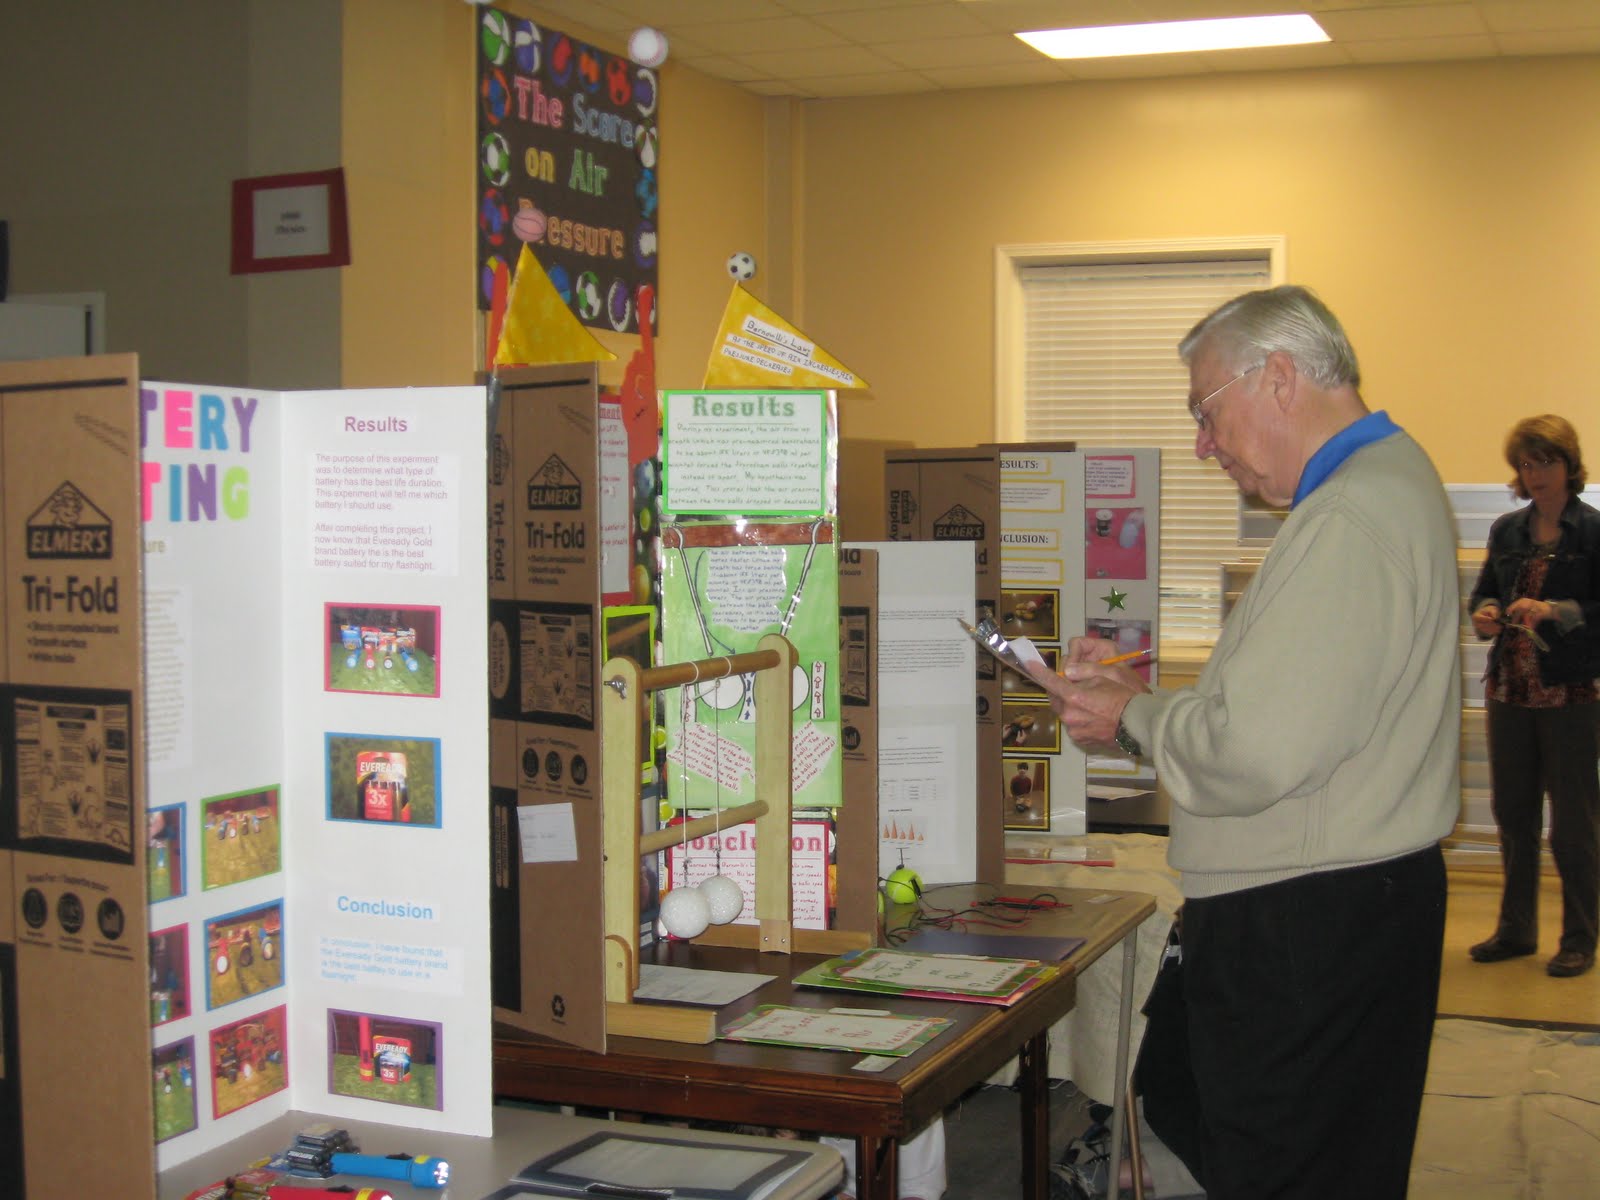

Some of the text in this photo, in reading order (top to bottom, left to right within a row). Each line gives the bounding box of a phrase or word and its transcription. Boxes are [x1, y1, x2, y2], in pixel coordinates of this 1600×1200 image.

[514, 75, 563, 128] The
[525, 147, 609, 196] on Air
[518, 198, 624, 259] essure
[743, 339, 755, 349] THE
[756, 343, 776, 354] SPEED
[723, 347, 792, 374] PRESSURE DECREASES
[692, 395, 795, 417] Results
[344, 416, 408, 432] Results
[316, 454, 439, 466] The purpose of this experiment
[342, 466, 382, 475] determine
[385, 467, 404, 475] what
[406, 467, 422, 477] type
[425, 466, 434, 475] of
[315, 478, 341, 488] battery
[344, 478, 359, 486] has
[361, 478, 373, 486] the
[375, 478, 392, 487] best
[394, 478, 406, 487] life
[140, 463, 249, 522] TING
[316, 488, 448, 500] This experiment will tell me which
[531, 488, 579, 506] ELMER'S
[315, 500, 341, 511] battery
[349, 501, 375, 510] should
[315, 523, 333, 531] After
[335, 524, 378, 535] completing
[380, 525, 394, 534] this
[525, 520, 585, 549] Tri-Fold
[936, 526, 981, 538] ELMER'S
[31, 530, 108, 553] ELMER'S
[333, 536, 353, 544] know
[355, 536, 371, 545] that
[373, 537, 410, 548] Eveready
[413, 537, 432, 547] Gold
[314, 546, 337, 555] brand
[339, 547, 366, 558] battery
[368, 549, 380, 557] the
[391, 549, 405, 558] the
[407, 549, 424, 558] best
[314, 557, 341, 568] battery
[343, 560, 367, 568] suited
[369, 560, 379, 568] for
[381, 562, 393, 571] my
[22, 575, 118, 614] Tri-Fold
[337, 895, 434, 920] Conclusion
[376, 1043, 408, 1053] EVEREADY
[384, 1068, 395, 1079] 3x
